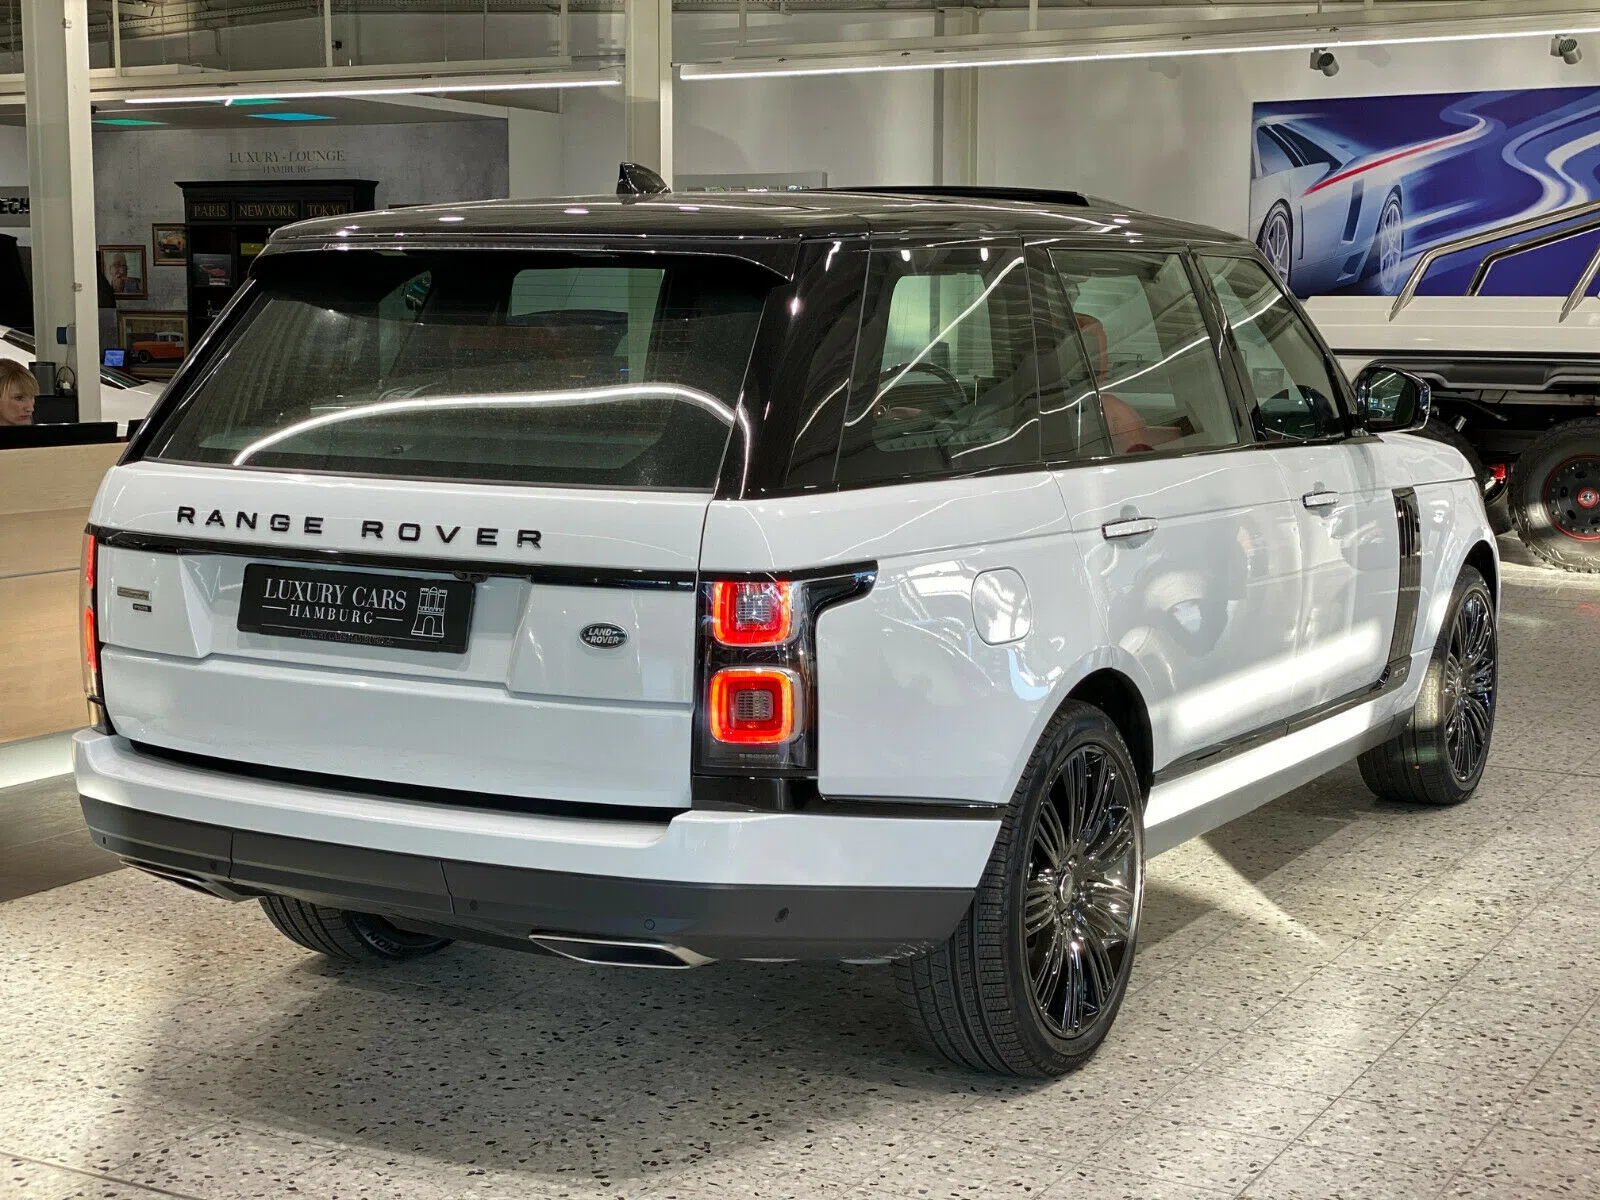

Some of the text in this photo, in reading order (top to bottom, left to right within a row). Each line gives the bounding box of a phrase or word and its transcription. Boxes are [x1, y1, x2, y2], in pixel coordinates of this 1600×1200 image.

[194, 205, 227, 217] PARIS
[239, 205, 296, 217] NEW YORK
[177, 506, 541, 549] RANGE ROVER
[263, 578, 407, 611] LUXURY CARS
[289, 604, 374, 625] HAMBURG
[588, 628, 612, 636] LAND
[590, 636, 620, 644] ROVER
